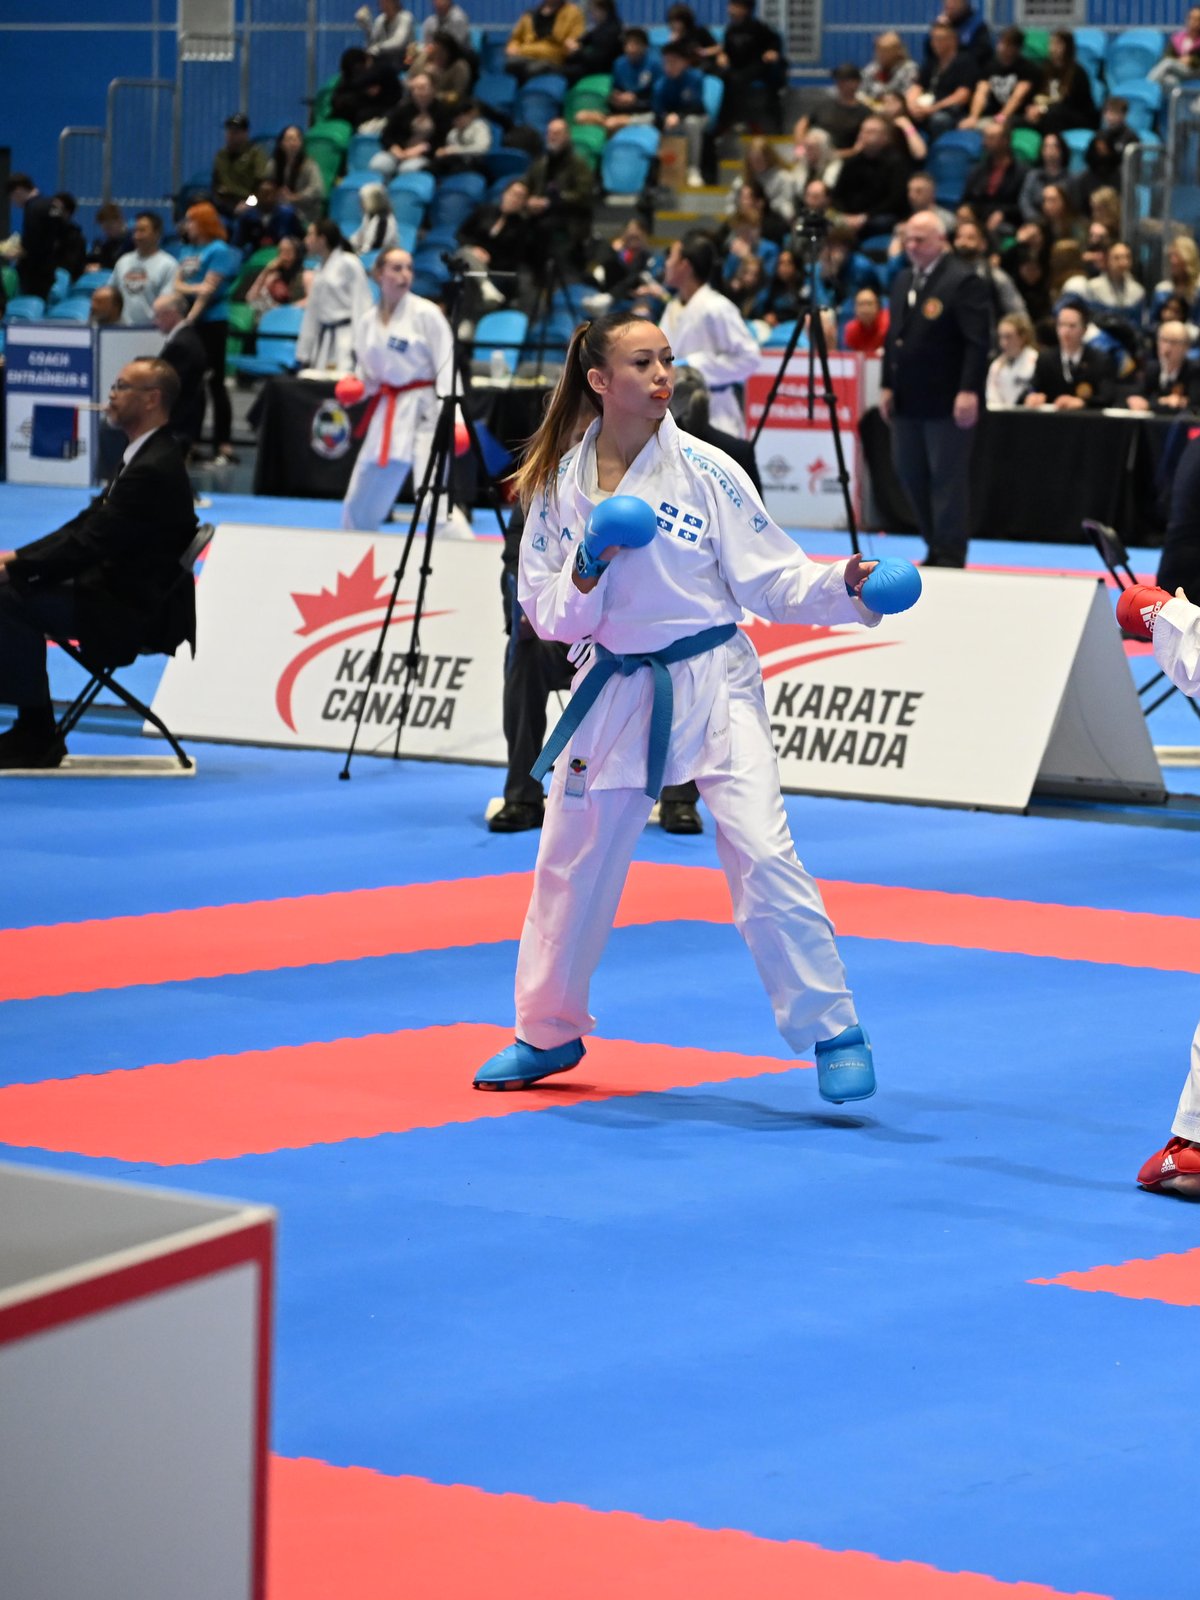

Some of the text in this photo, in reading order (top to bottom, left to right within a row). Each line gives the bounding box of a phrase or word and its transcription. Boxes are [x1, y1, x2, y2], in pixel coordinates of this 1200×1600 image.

[335, 649, 473, 691] KARATE
[321, 688, 456, 730] CANADA
[772, 682, 924, 727] KARATE
[770, 723, 908, 769] CANADA
